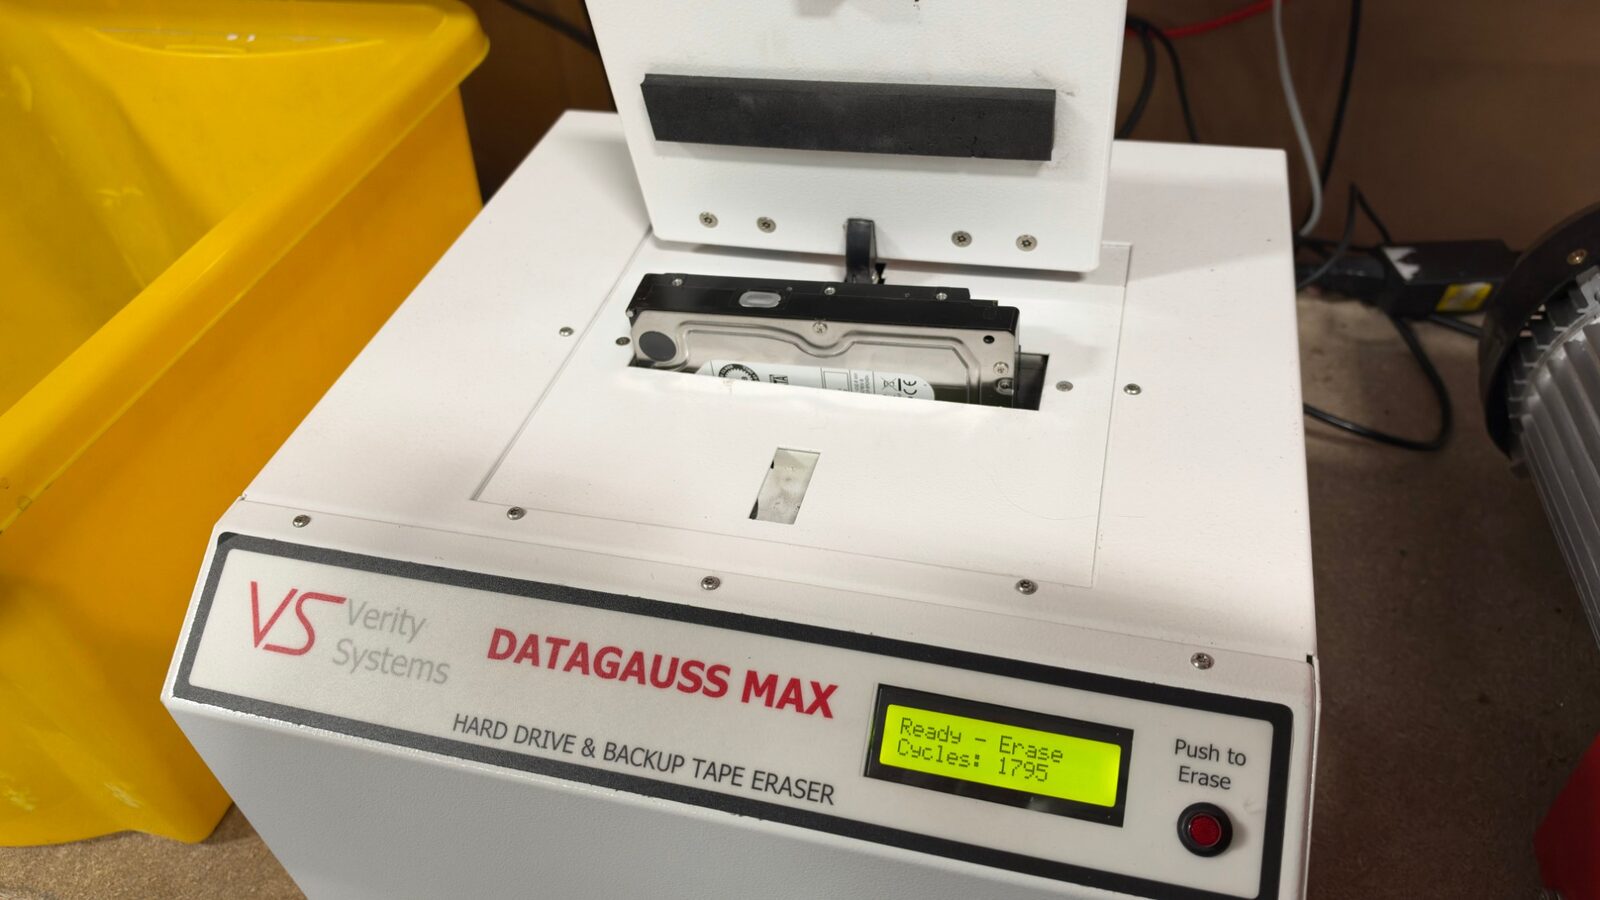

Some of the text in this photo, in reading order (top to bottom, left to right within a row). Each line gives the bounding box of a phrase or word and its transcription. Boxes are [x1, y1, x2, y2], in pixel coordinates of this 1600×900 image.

[249, 580, 346, 657] VS
[348, 598, 427, 644] Verity
[332, 638, 451, 686] Systems
[487, 627, 838, 720] DATAGAUSS MAX
[452, 713, 835, 806] HARD DRIVE & BACKUP TAPE ERASER
[897, 738, 1049, 782] Cycles: 1795
[900, 717, 962, 745] Ready
[998, 735, 1064, 763] Erase
[1174, 738, 1247, 767] Push to
[1178, 765, 1232, 791] Erase
